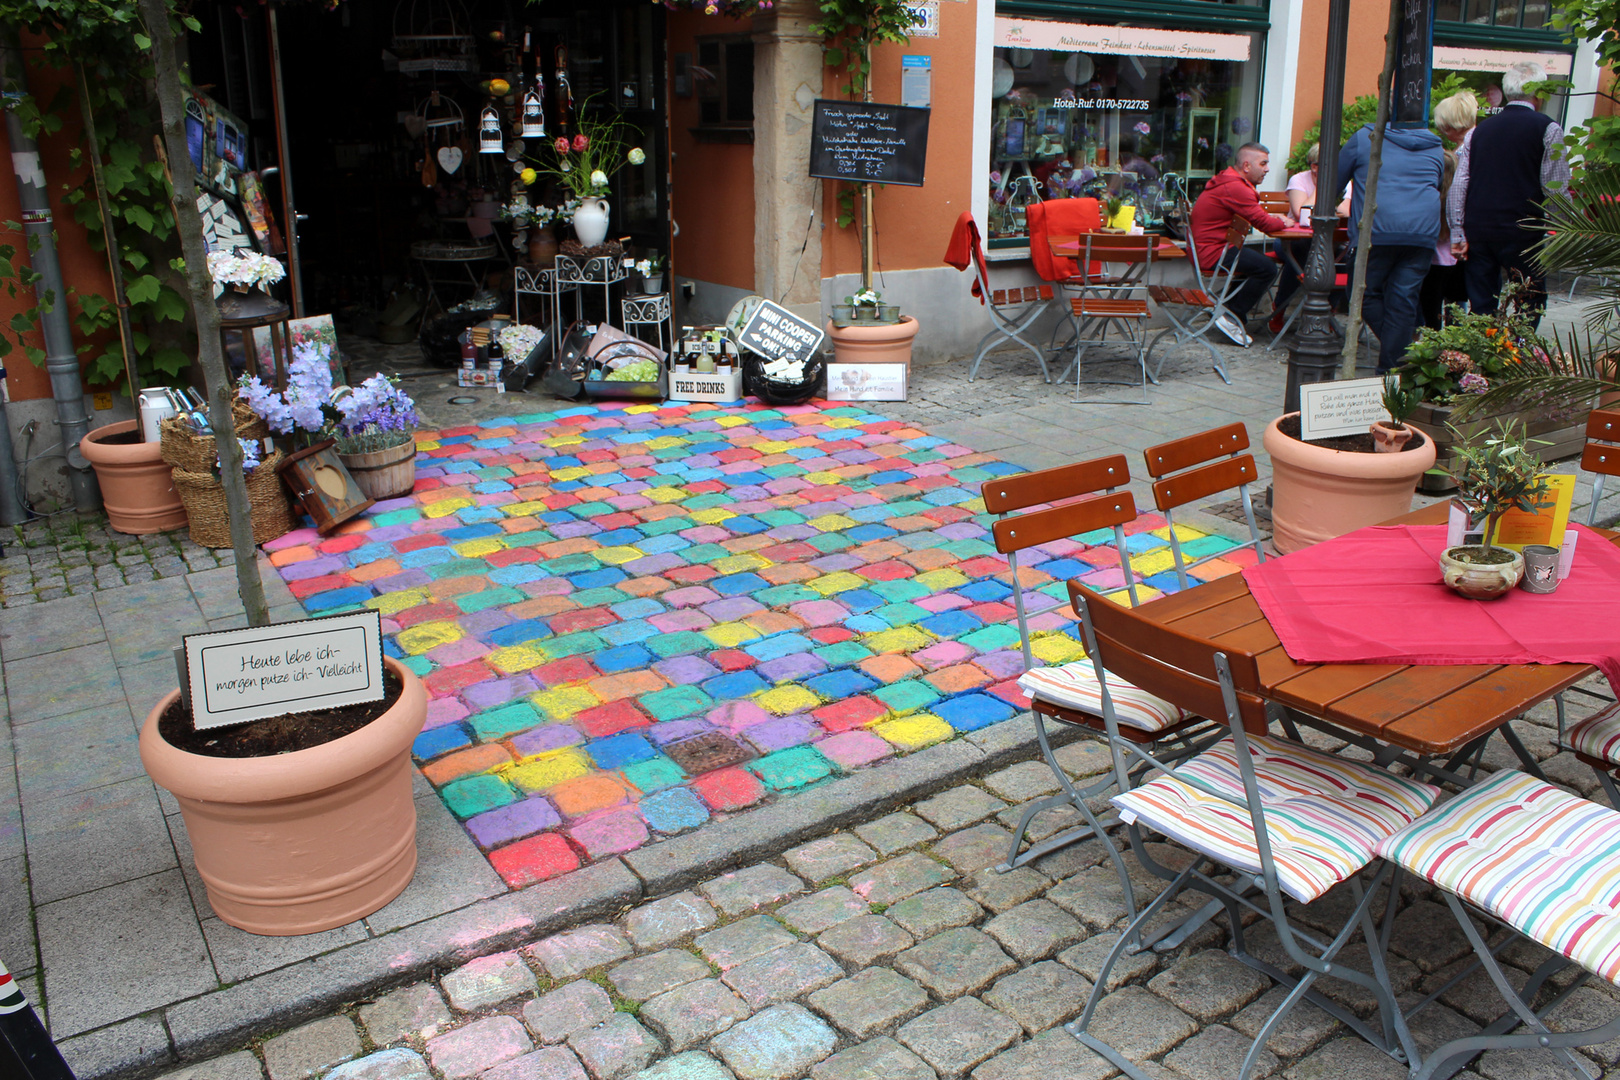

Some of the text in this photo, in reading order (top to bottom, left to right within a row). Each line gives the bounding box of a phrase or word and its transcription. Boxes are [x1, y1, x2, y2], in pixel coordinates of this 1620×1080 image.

[1057, 36, 1098, 46] Mediterrane
[1100, 38, 1131, 50] Feinkost
[1053, 98, 1150, 110] Hotel-Ruf: 0170-5722735
[760, 307, 816, 346] MINI COOPER
[759, 322, 802, 352] PARKING
[762, 338, 786, 356] ONLY
[676, 381, 725, 394] FREE DRINKS
[1314, 412, 1334, 422] putzen
[241, 644, 340, 672] Heute lebe ich-
[216, 662, 363, 694] morgen putze ich- Vielleicht
